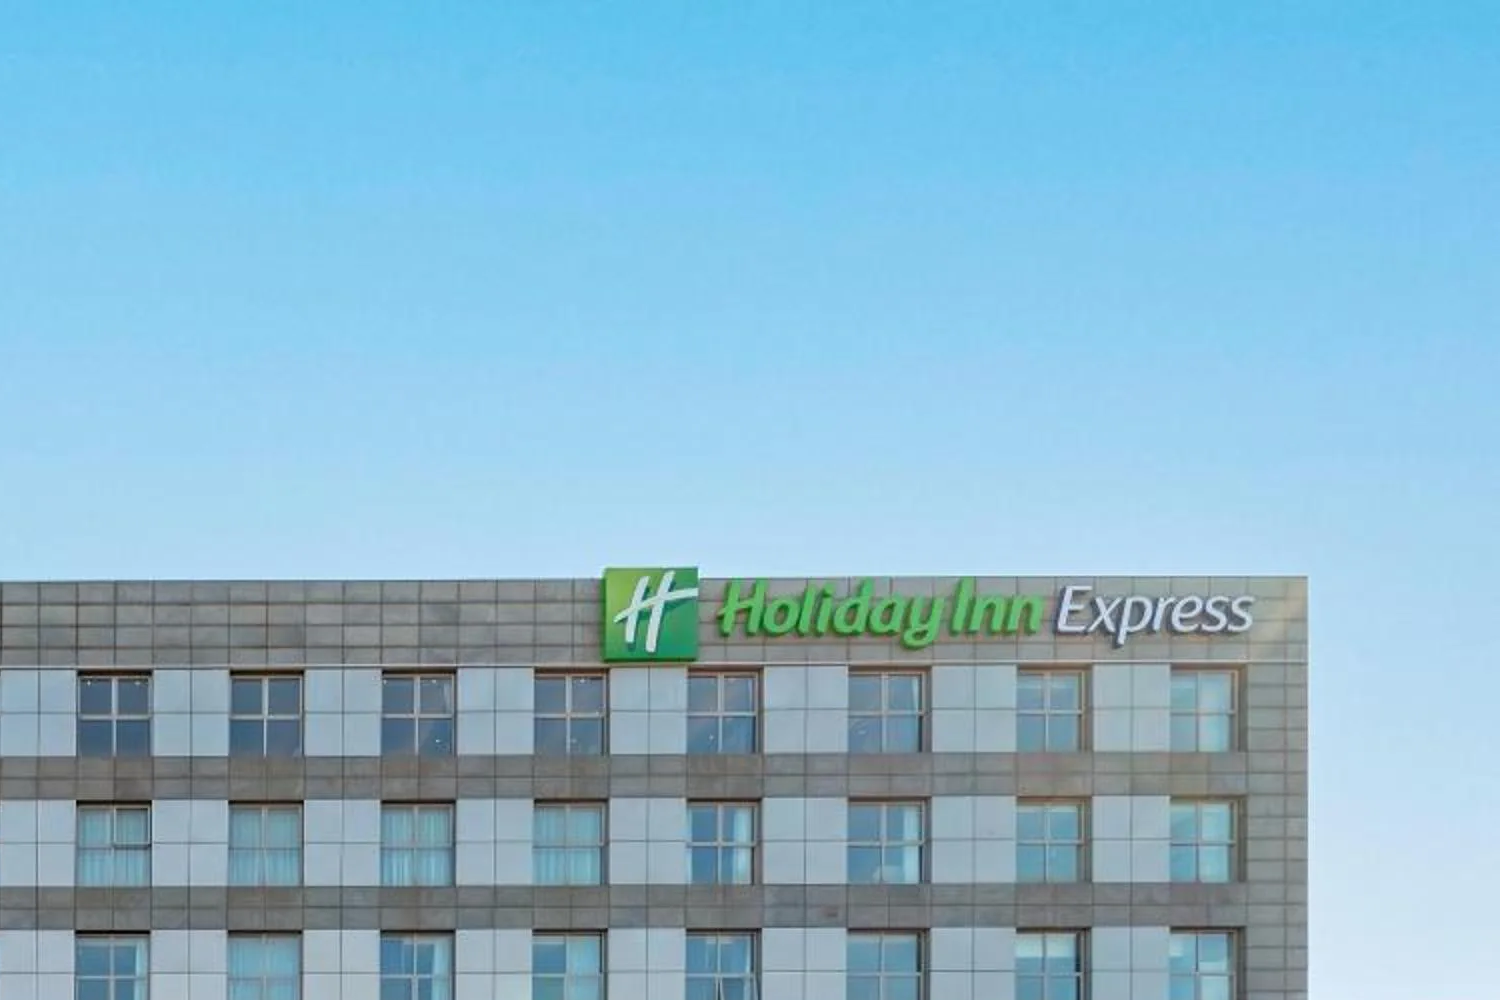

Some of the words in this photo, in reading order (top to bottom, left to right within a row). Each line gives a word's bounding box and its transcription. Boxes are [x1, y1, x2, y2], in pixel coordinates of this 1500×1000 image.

[613, 570, 699, 653] H
[716, 577, 945, 650] Holiday
[950, 576, 1044, 634] Inn
[1055, 585, 1255, 648] Express
